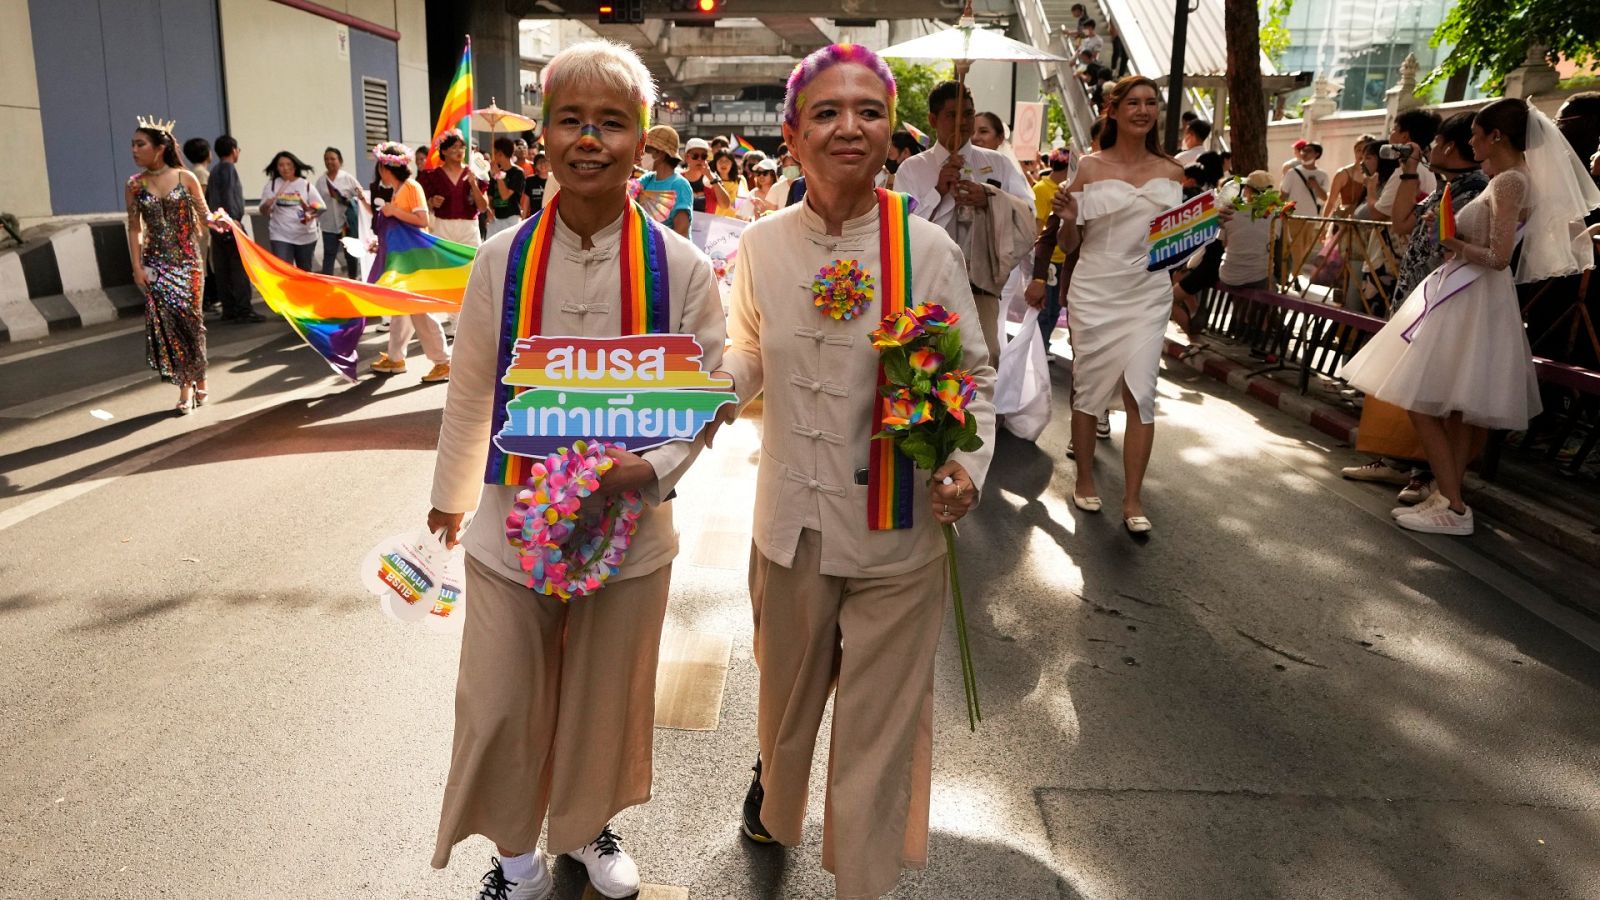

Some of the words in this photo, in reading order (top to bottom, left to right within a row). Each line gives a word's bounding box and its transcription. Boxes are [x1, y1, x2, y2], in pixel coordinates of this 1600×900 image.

[1160, 202, 1203, 234] สมรส
[704, 235, 727, 255] Chiang
[1155, 225, 1214, 262] เท่าเทียม
[544, 346, 666, 381] สมรส
[526, 392, 694, 439] เท่าเทียม
